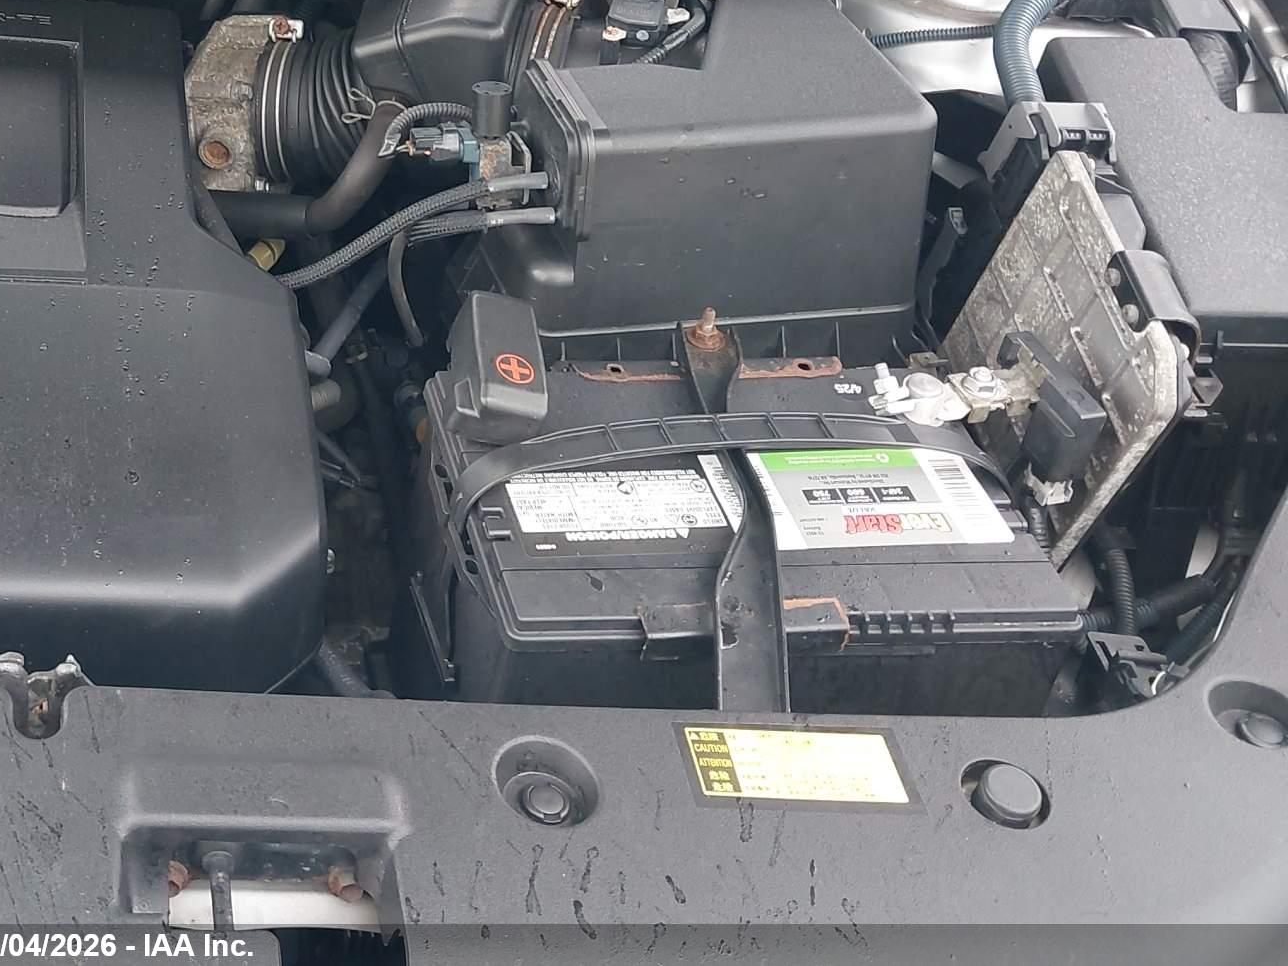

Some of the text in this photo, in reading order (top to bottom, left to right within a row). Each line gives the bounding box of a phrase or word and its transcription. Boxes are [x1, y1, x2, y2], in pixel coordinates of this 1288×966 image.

[844, 512, 953, 536] EverStart
[694, 743, 729, 753] CAUTION
[698, 757, 733, 768] ATTENTION
